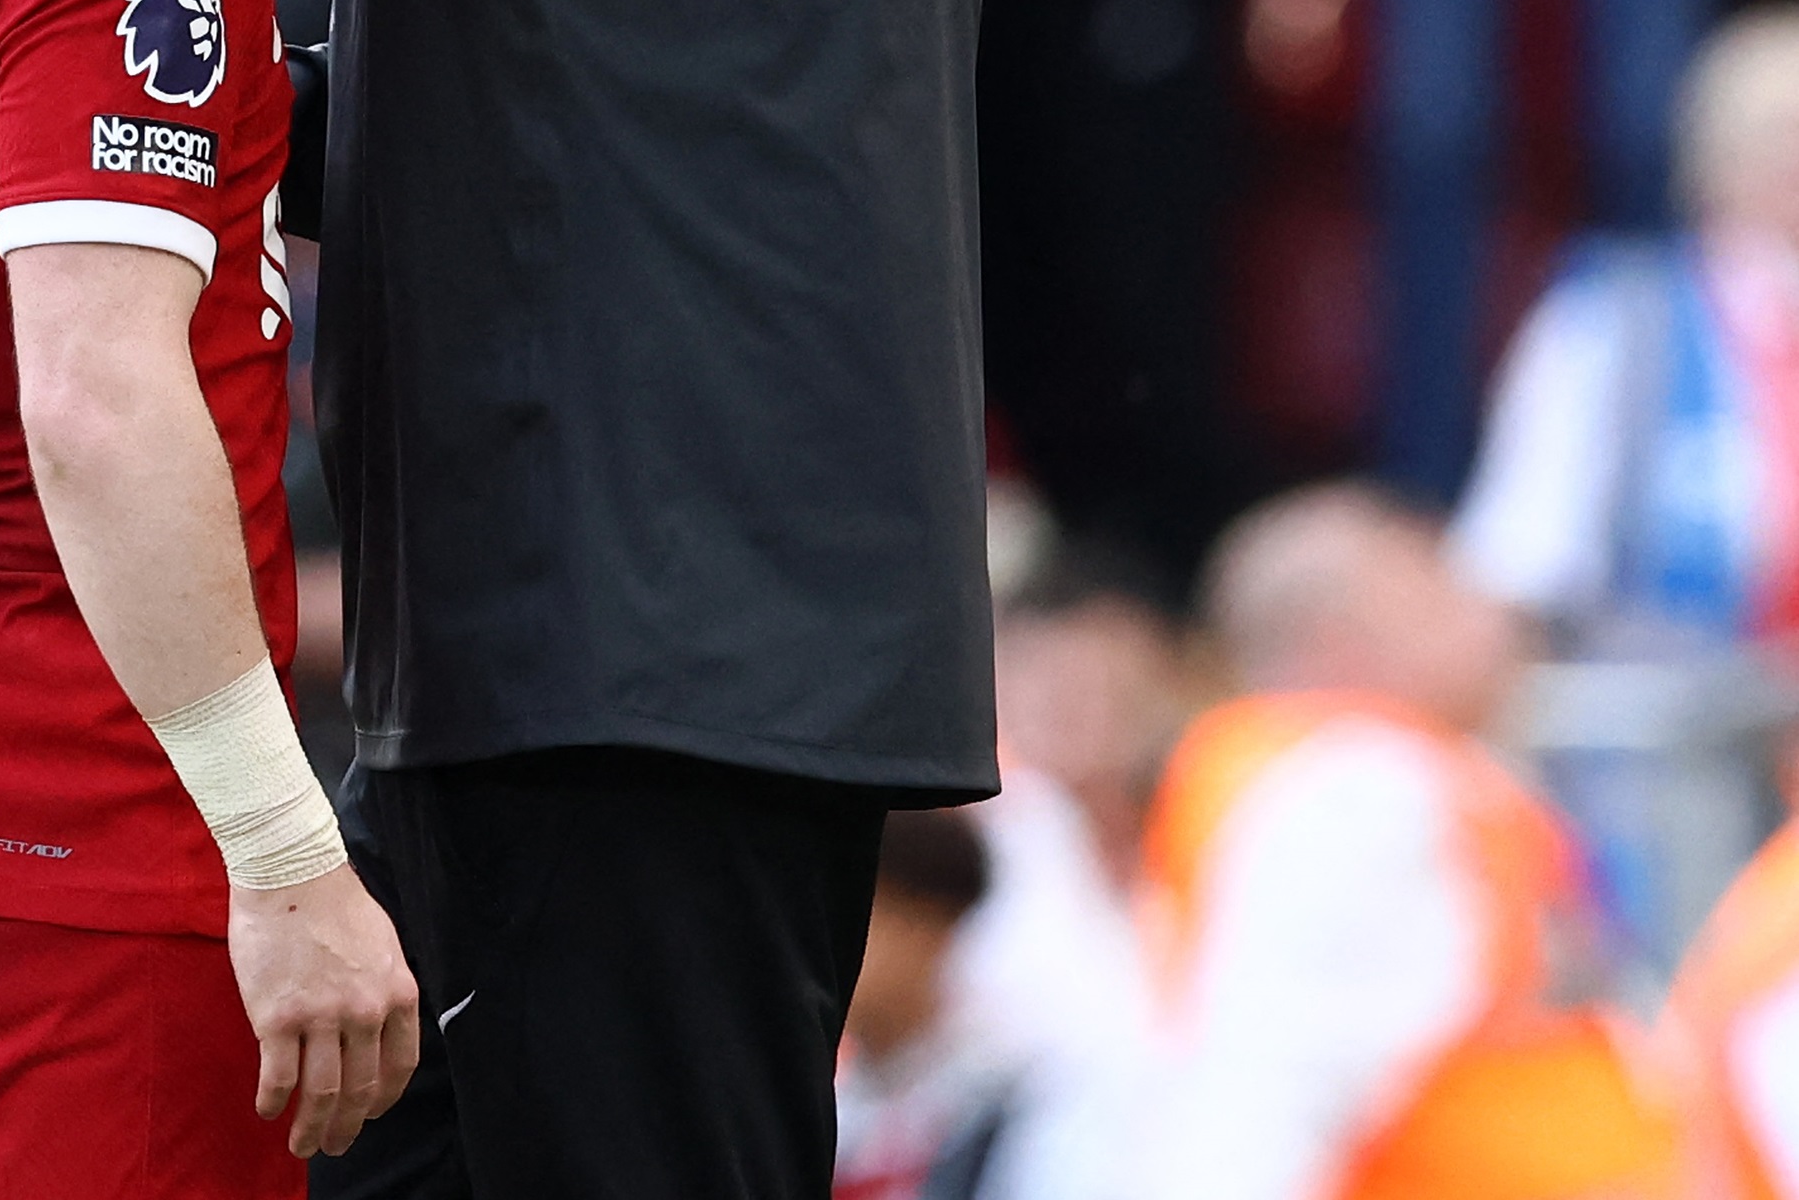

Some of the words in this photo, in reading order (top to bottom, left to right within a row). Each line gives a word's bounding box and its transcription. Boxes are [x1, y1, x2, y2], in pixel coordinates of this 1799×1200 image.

[93, 116, 139, 147] No
[144, 125, 211, 160] room
[92, 142, 138, 170] for
[142, 150, 215, 188] racism
